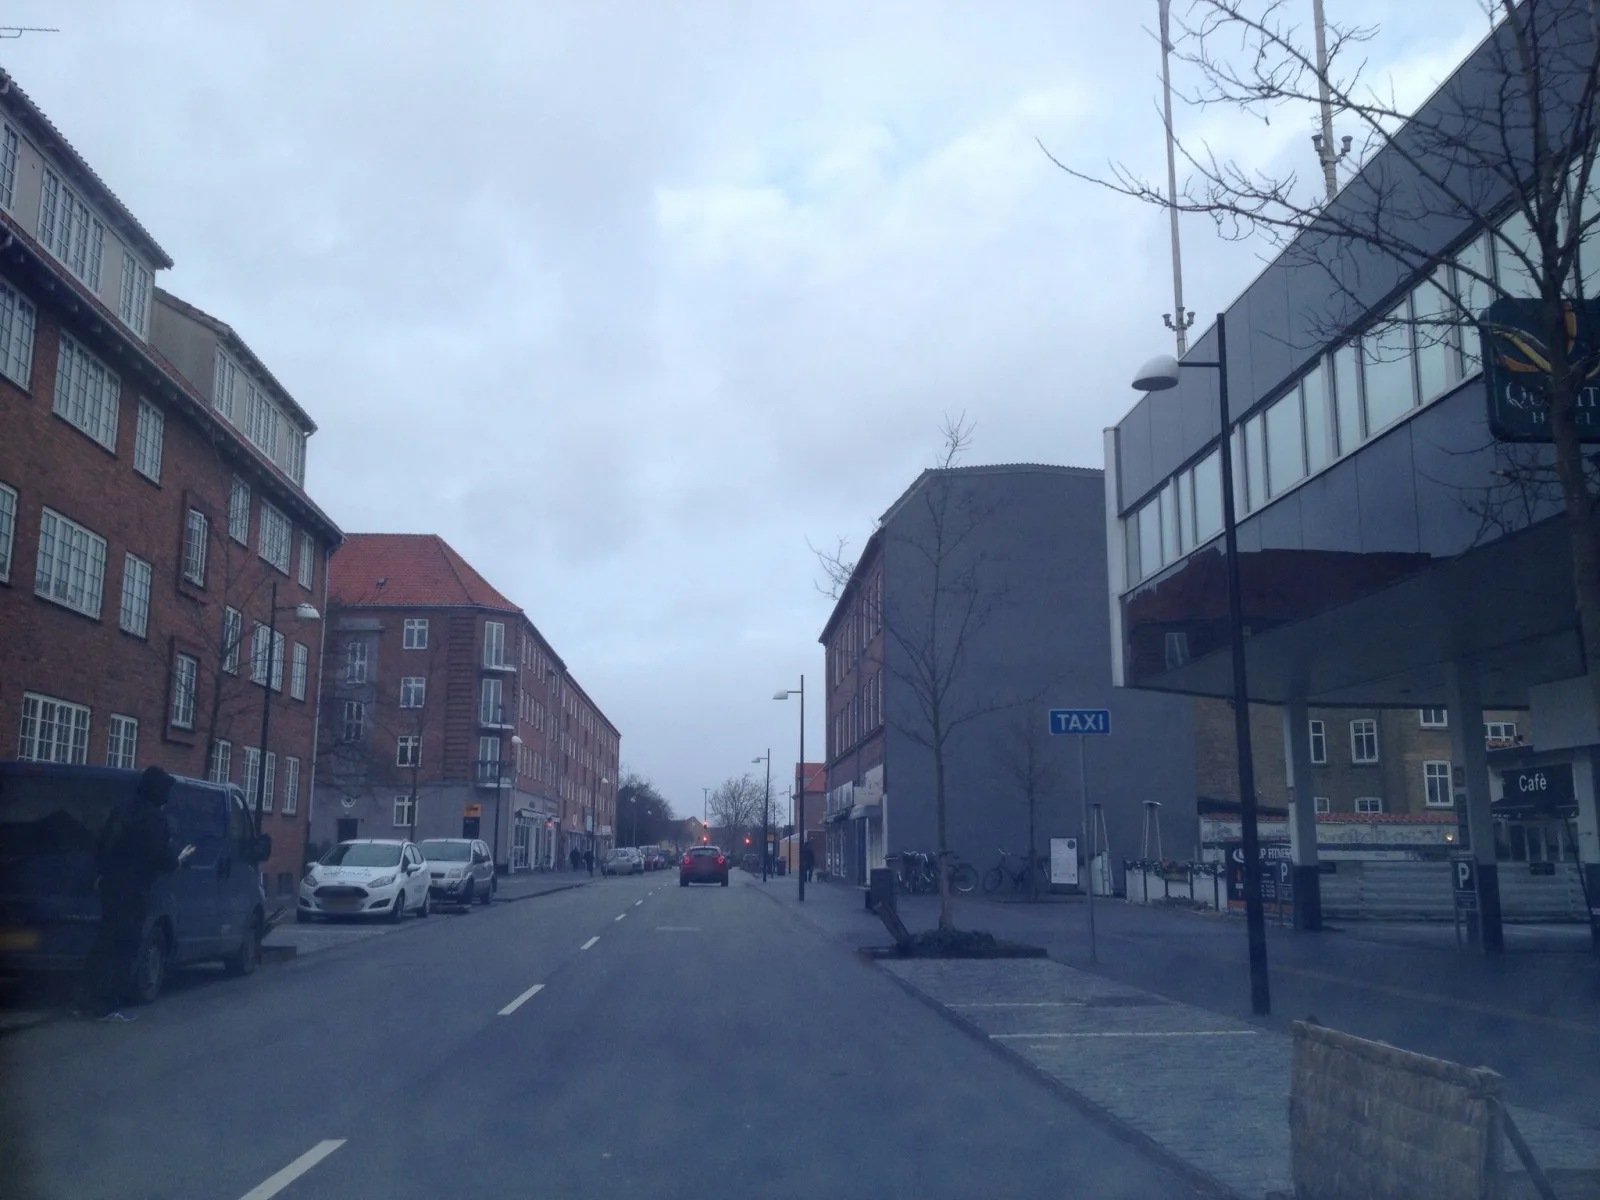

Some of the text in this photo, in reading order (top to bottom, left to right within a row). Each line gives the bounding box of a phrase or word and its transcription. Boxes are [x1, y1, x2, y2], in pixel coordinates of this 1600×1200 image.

[1532, 411, 1595, 425] HEL
[1056, 713, 1104, 731] TAXI
[1280, 862, 1288, 883] P
[1457, 862, 1470, 889] P
